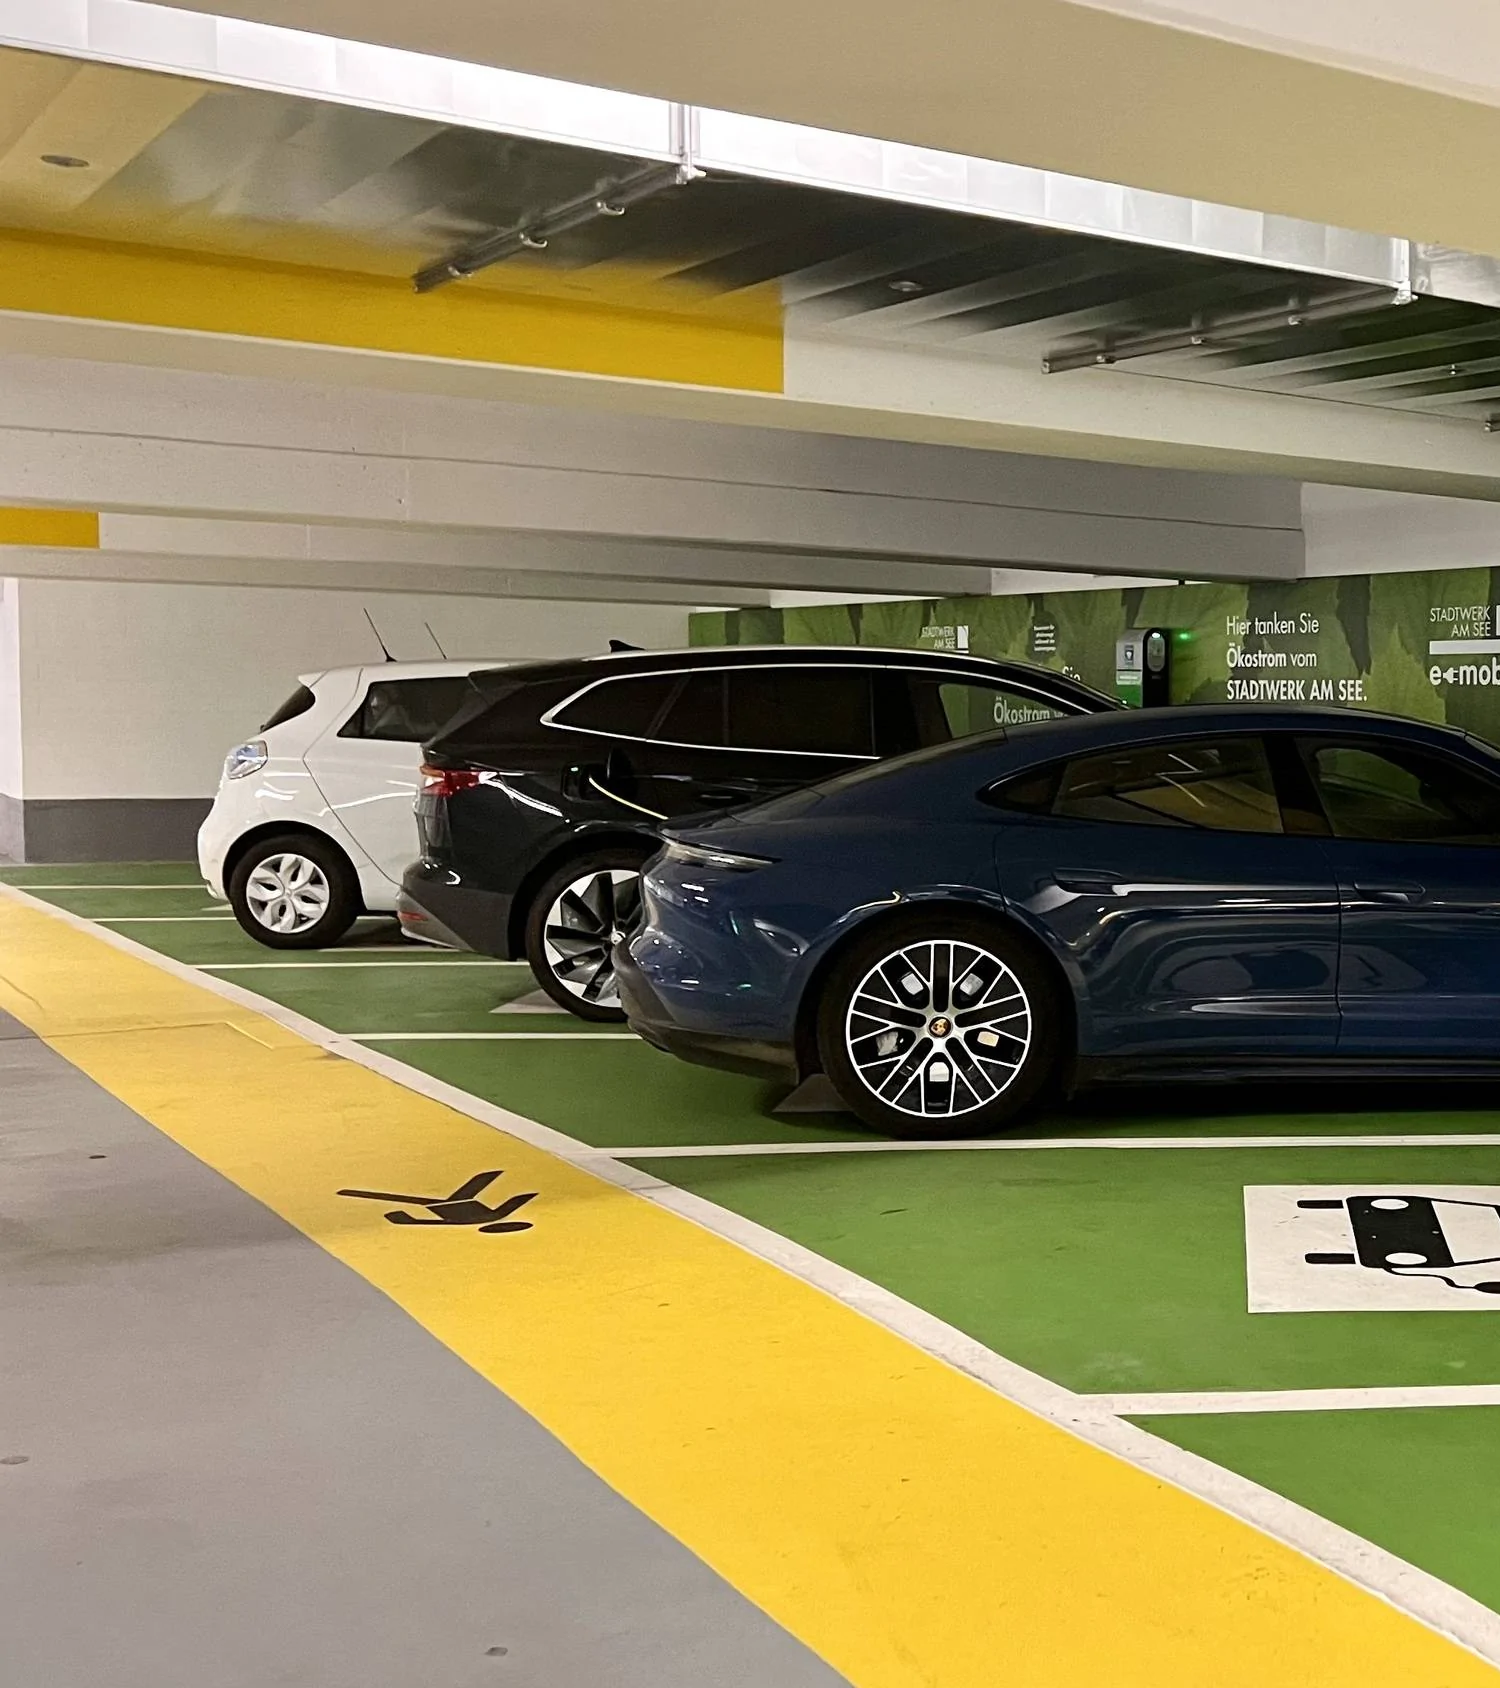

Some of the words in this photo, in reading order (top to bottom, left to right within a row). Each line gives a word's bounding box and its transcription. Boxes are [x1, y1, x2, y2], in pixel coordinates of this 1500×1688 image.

[1226, 616, 1251, 635] Hier
[1255, 611, 1295, 634] tanken
[1300, 612, 1320, 633] Sie
[1430, 605, 1491, 622] STADTWERK
[1451, 625, 1470, 637] AM
[1474, 622, 1491, 636] SEE
[1226, 642, 1287, 668] Ökostrom
[1290, 652, 1317, 667] vom
[1226, 679, 1305, 700] STADTWERK
[1310, 679, 1334, 701] AM
[1338, 679, 1368, 702] SEE.
[993, 696, 1051, 724] Ökostrom
